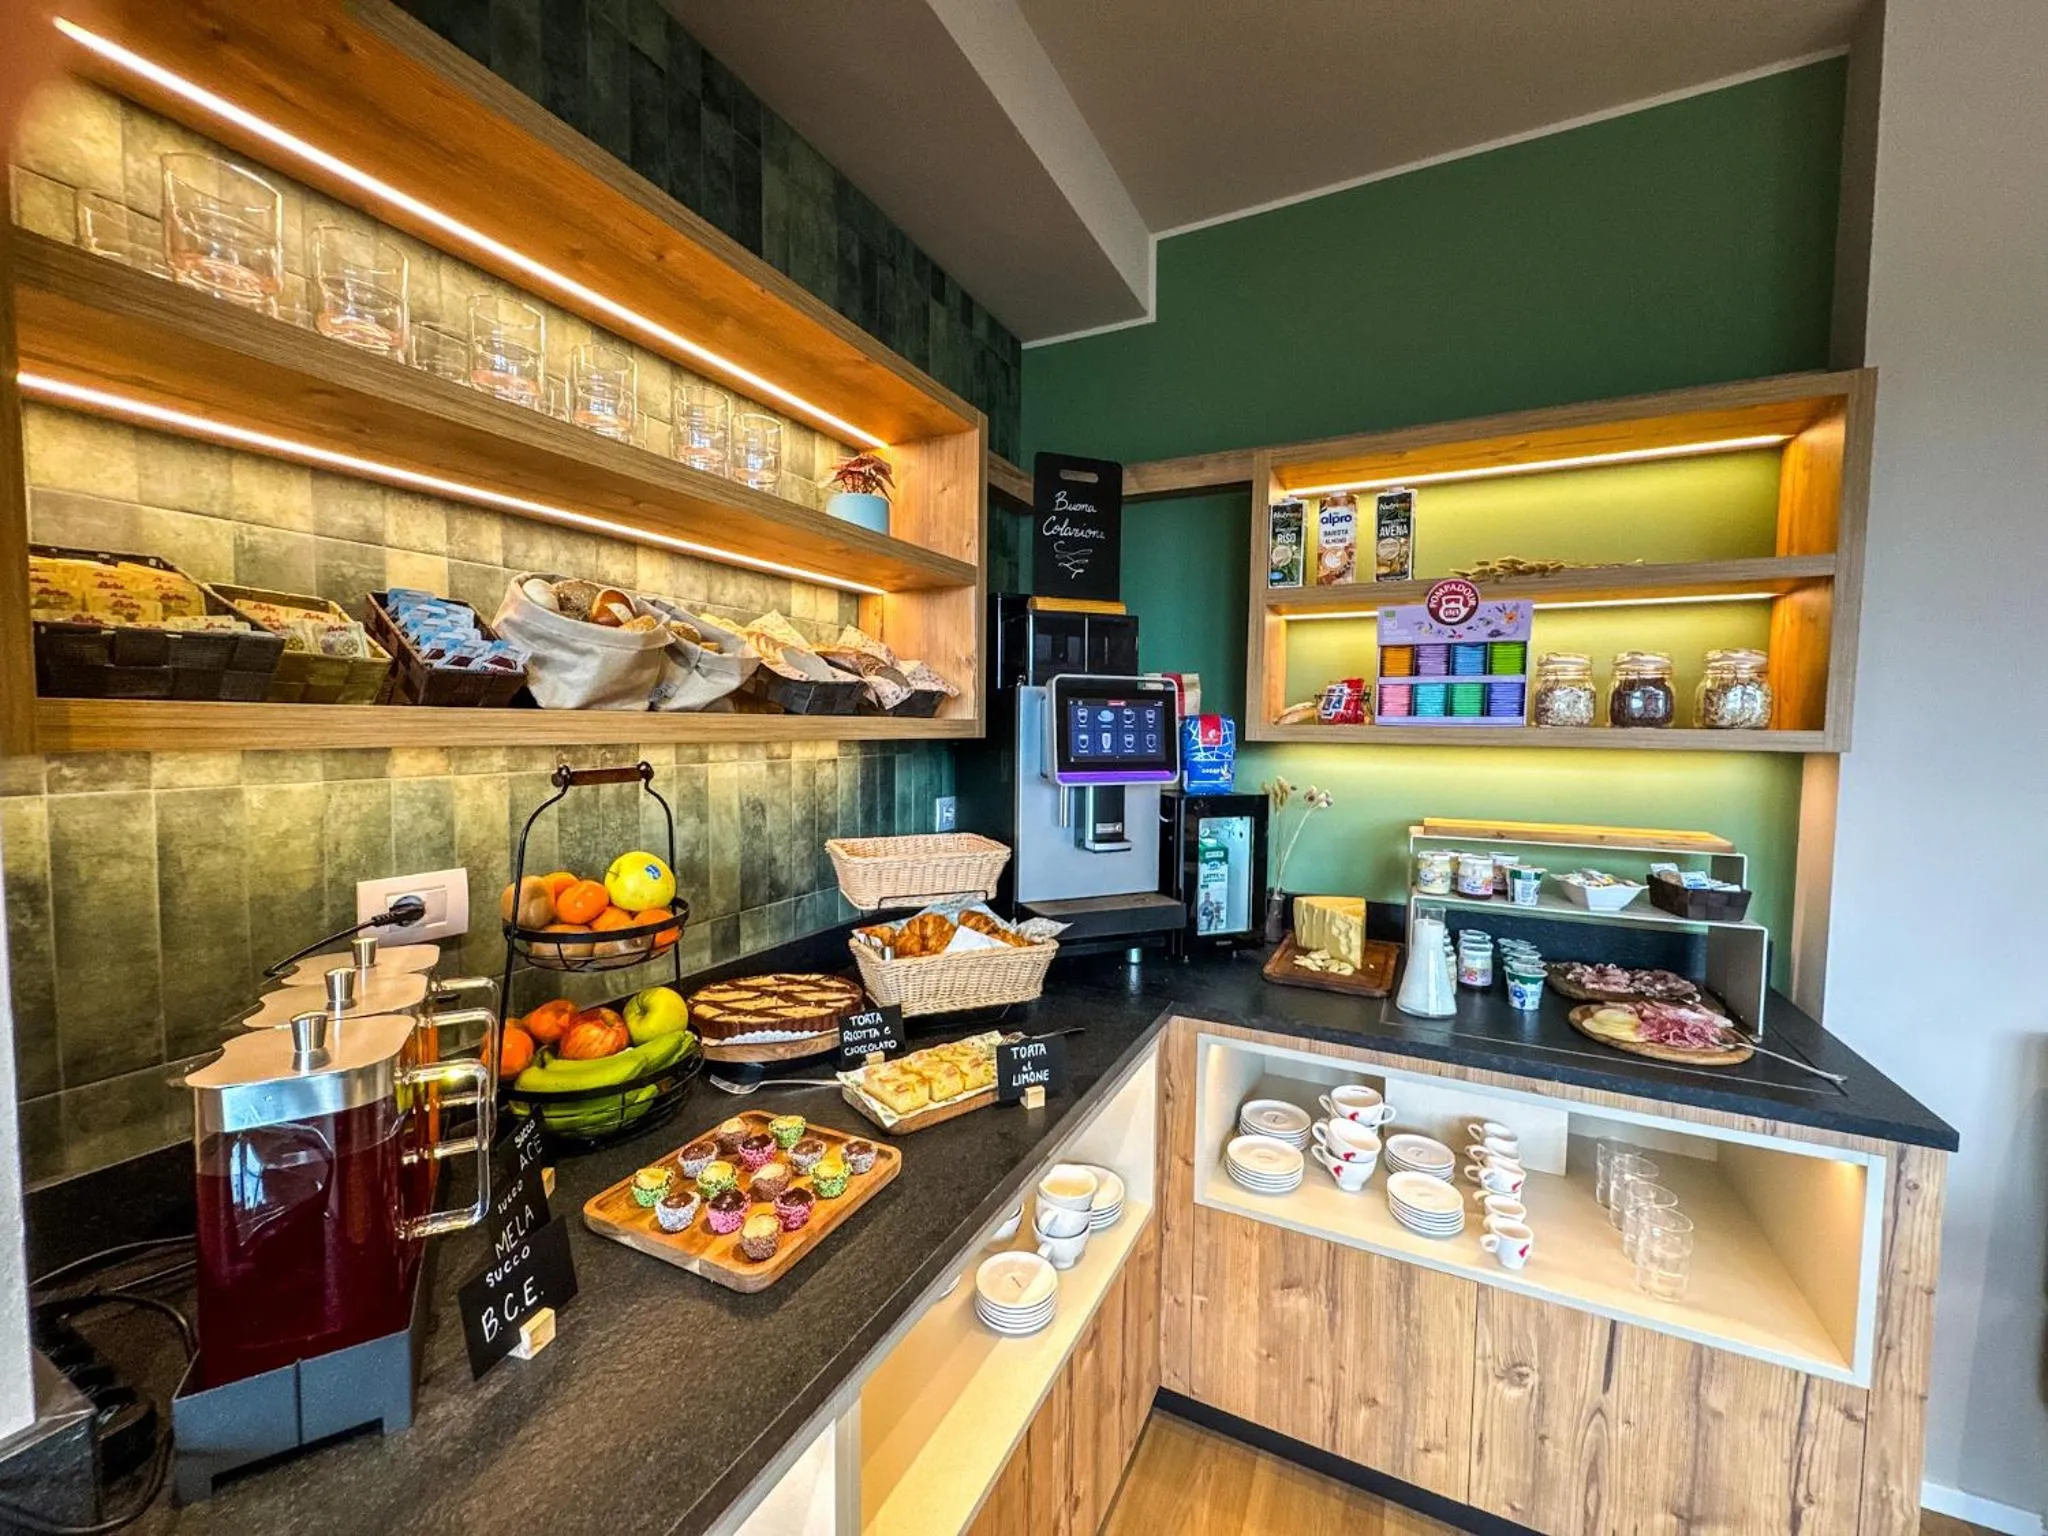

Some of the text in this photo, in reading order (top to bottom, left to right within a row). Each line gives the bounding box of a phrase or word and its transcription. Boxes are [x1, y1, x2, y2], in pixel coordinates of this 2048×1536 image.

[1054, 490, 1098, 513] Buona
[1042, 515, 1106, 540] Colazione
[1320, 512, 1353, 527] alpro
[1277, 532, 1297, 544] RISO
[1379, 524, 1409, 538] AVENA
[1428, 583, 1477, 608] POMPADOUR
[849, 1012, 883, 1026] TORTA
[843, 1027, 880, 1042] RICOTTA
[844, 1039, 897, 1056] CIOCCOLATO
[1010, 1042, 1047, 1060] TORTA
[1012, 1069, 1050, 1087] LIMONE
[494, 1203, 535, 1260] MELA
[486, 1244, 531, 1289] SUCCO
